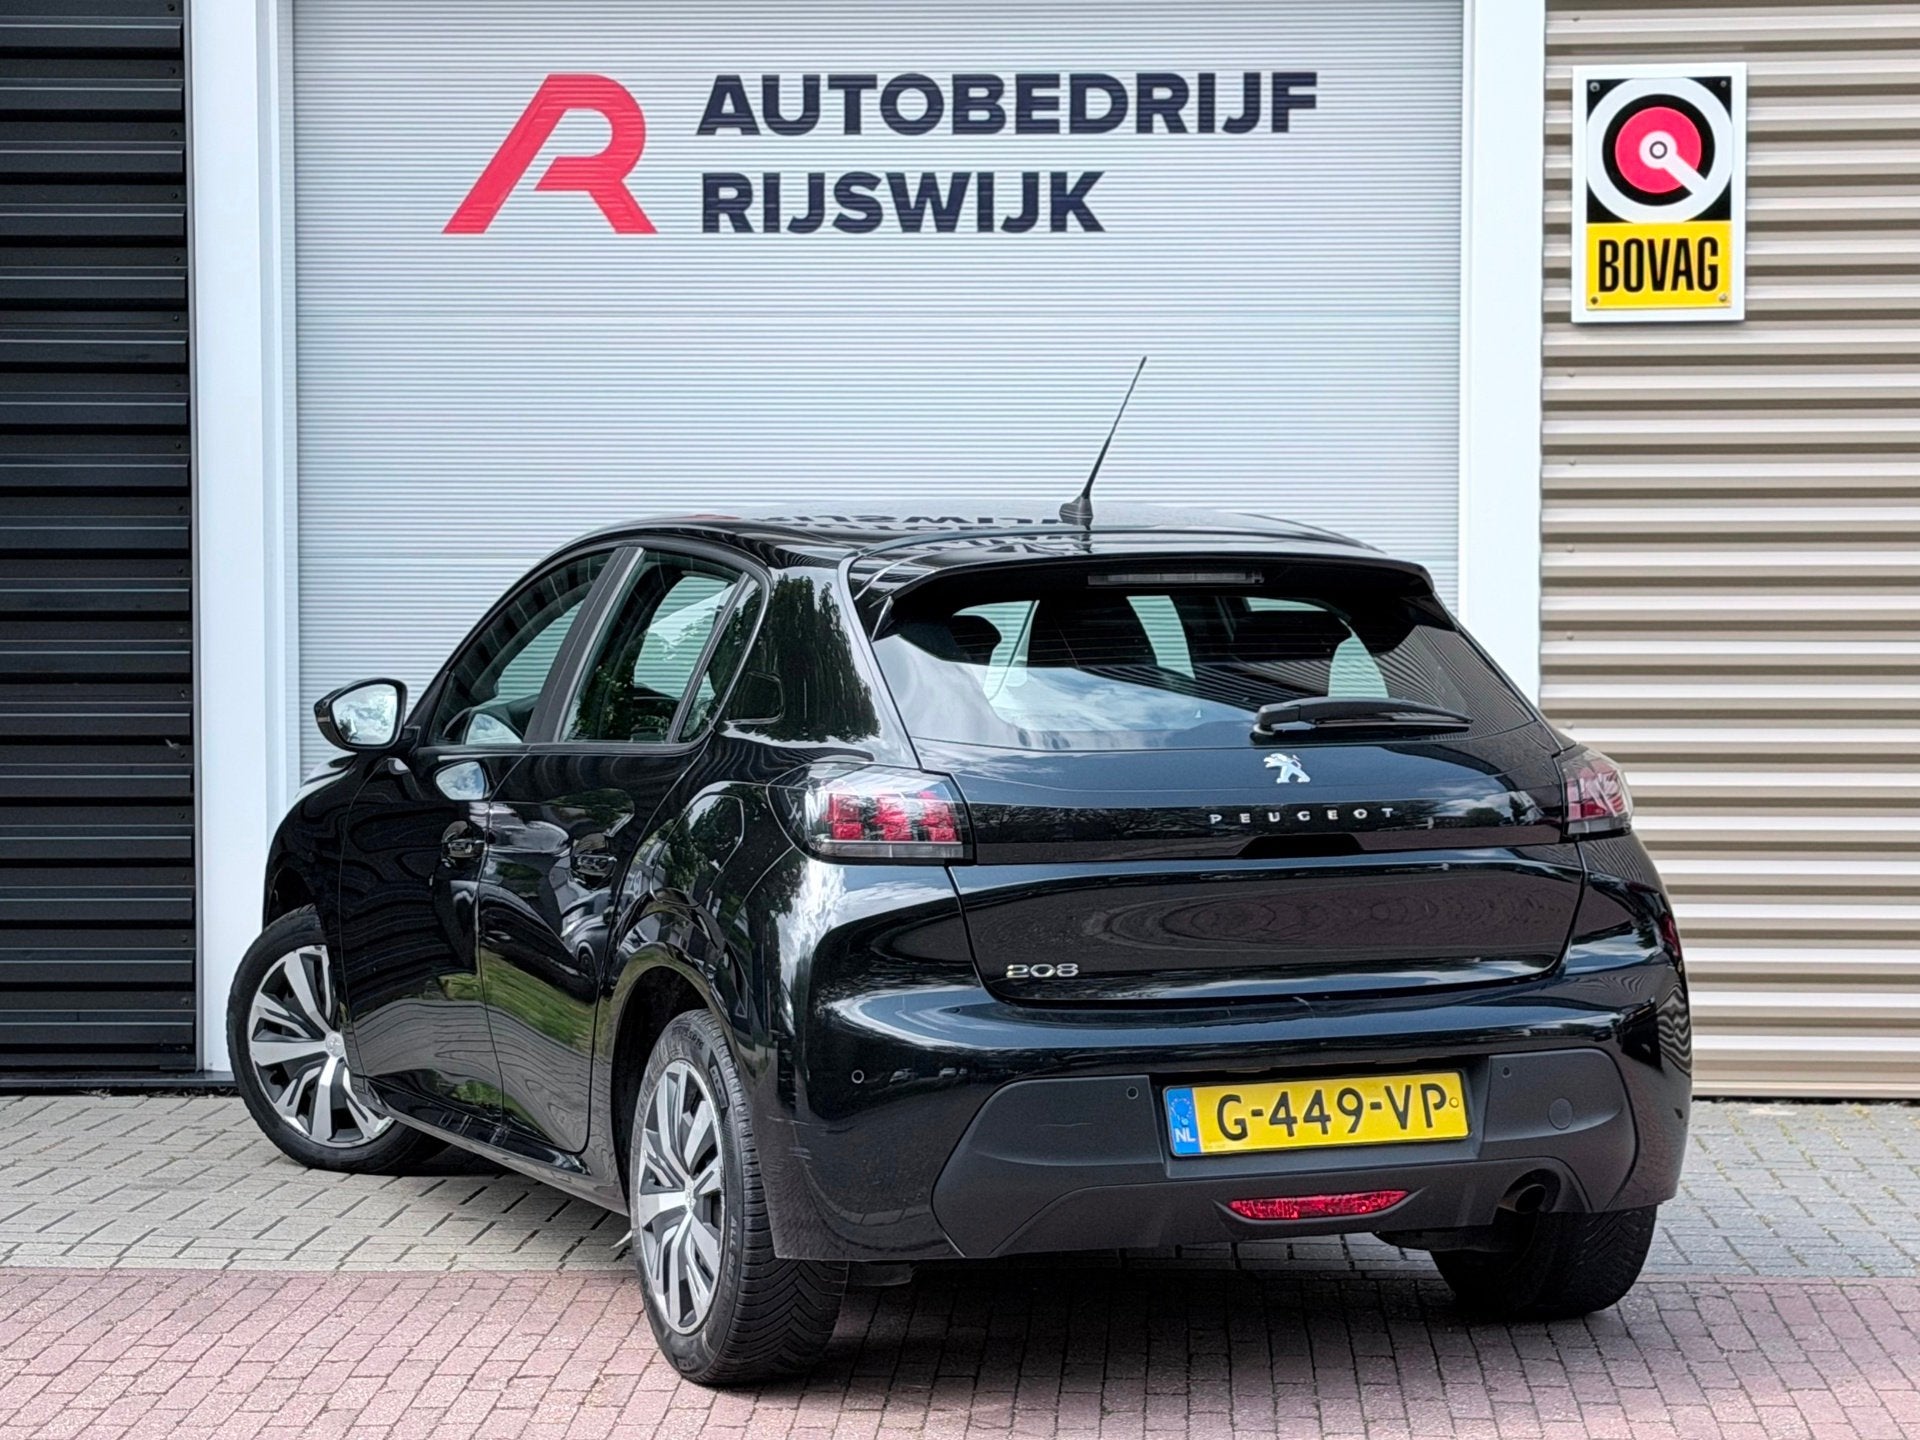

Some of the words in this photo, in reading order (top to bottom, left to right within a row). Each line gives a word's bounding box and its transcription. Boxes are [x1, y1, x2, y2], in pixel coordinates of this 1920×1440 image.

[697, 72, 1317, 135] AUTOBEDRIJF
[703, 172, 1104, 233] RIJSWIJK
[1599, 236, 1718, 292] BOVAG
[1209, 807, 1394, 824] PEUGEOT
[1006, 963, 1079, 978] 208
[1174, 1127, 1197, 1143] NL
[1217, 1083, 1447, 1141] G-449-VP
